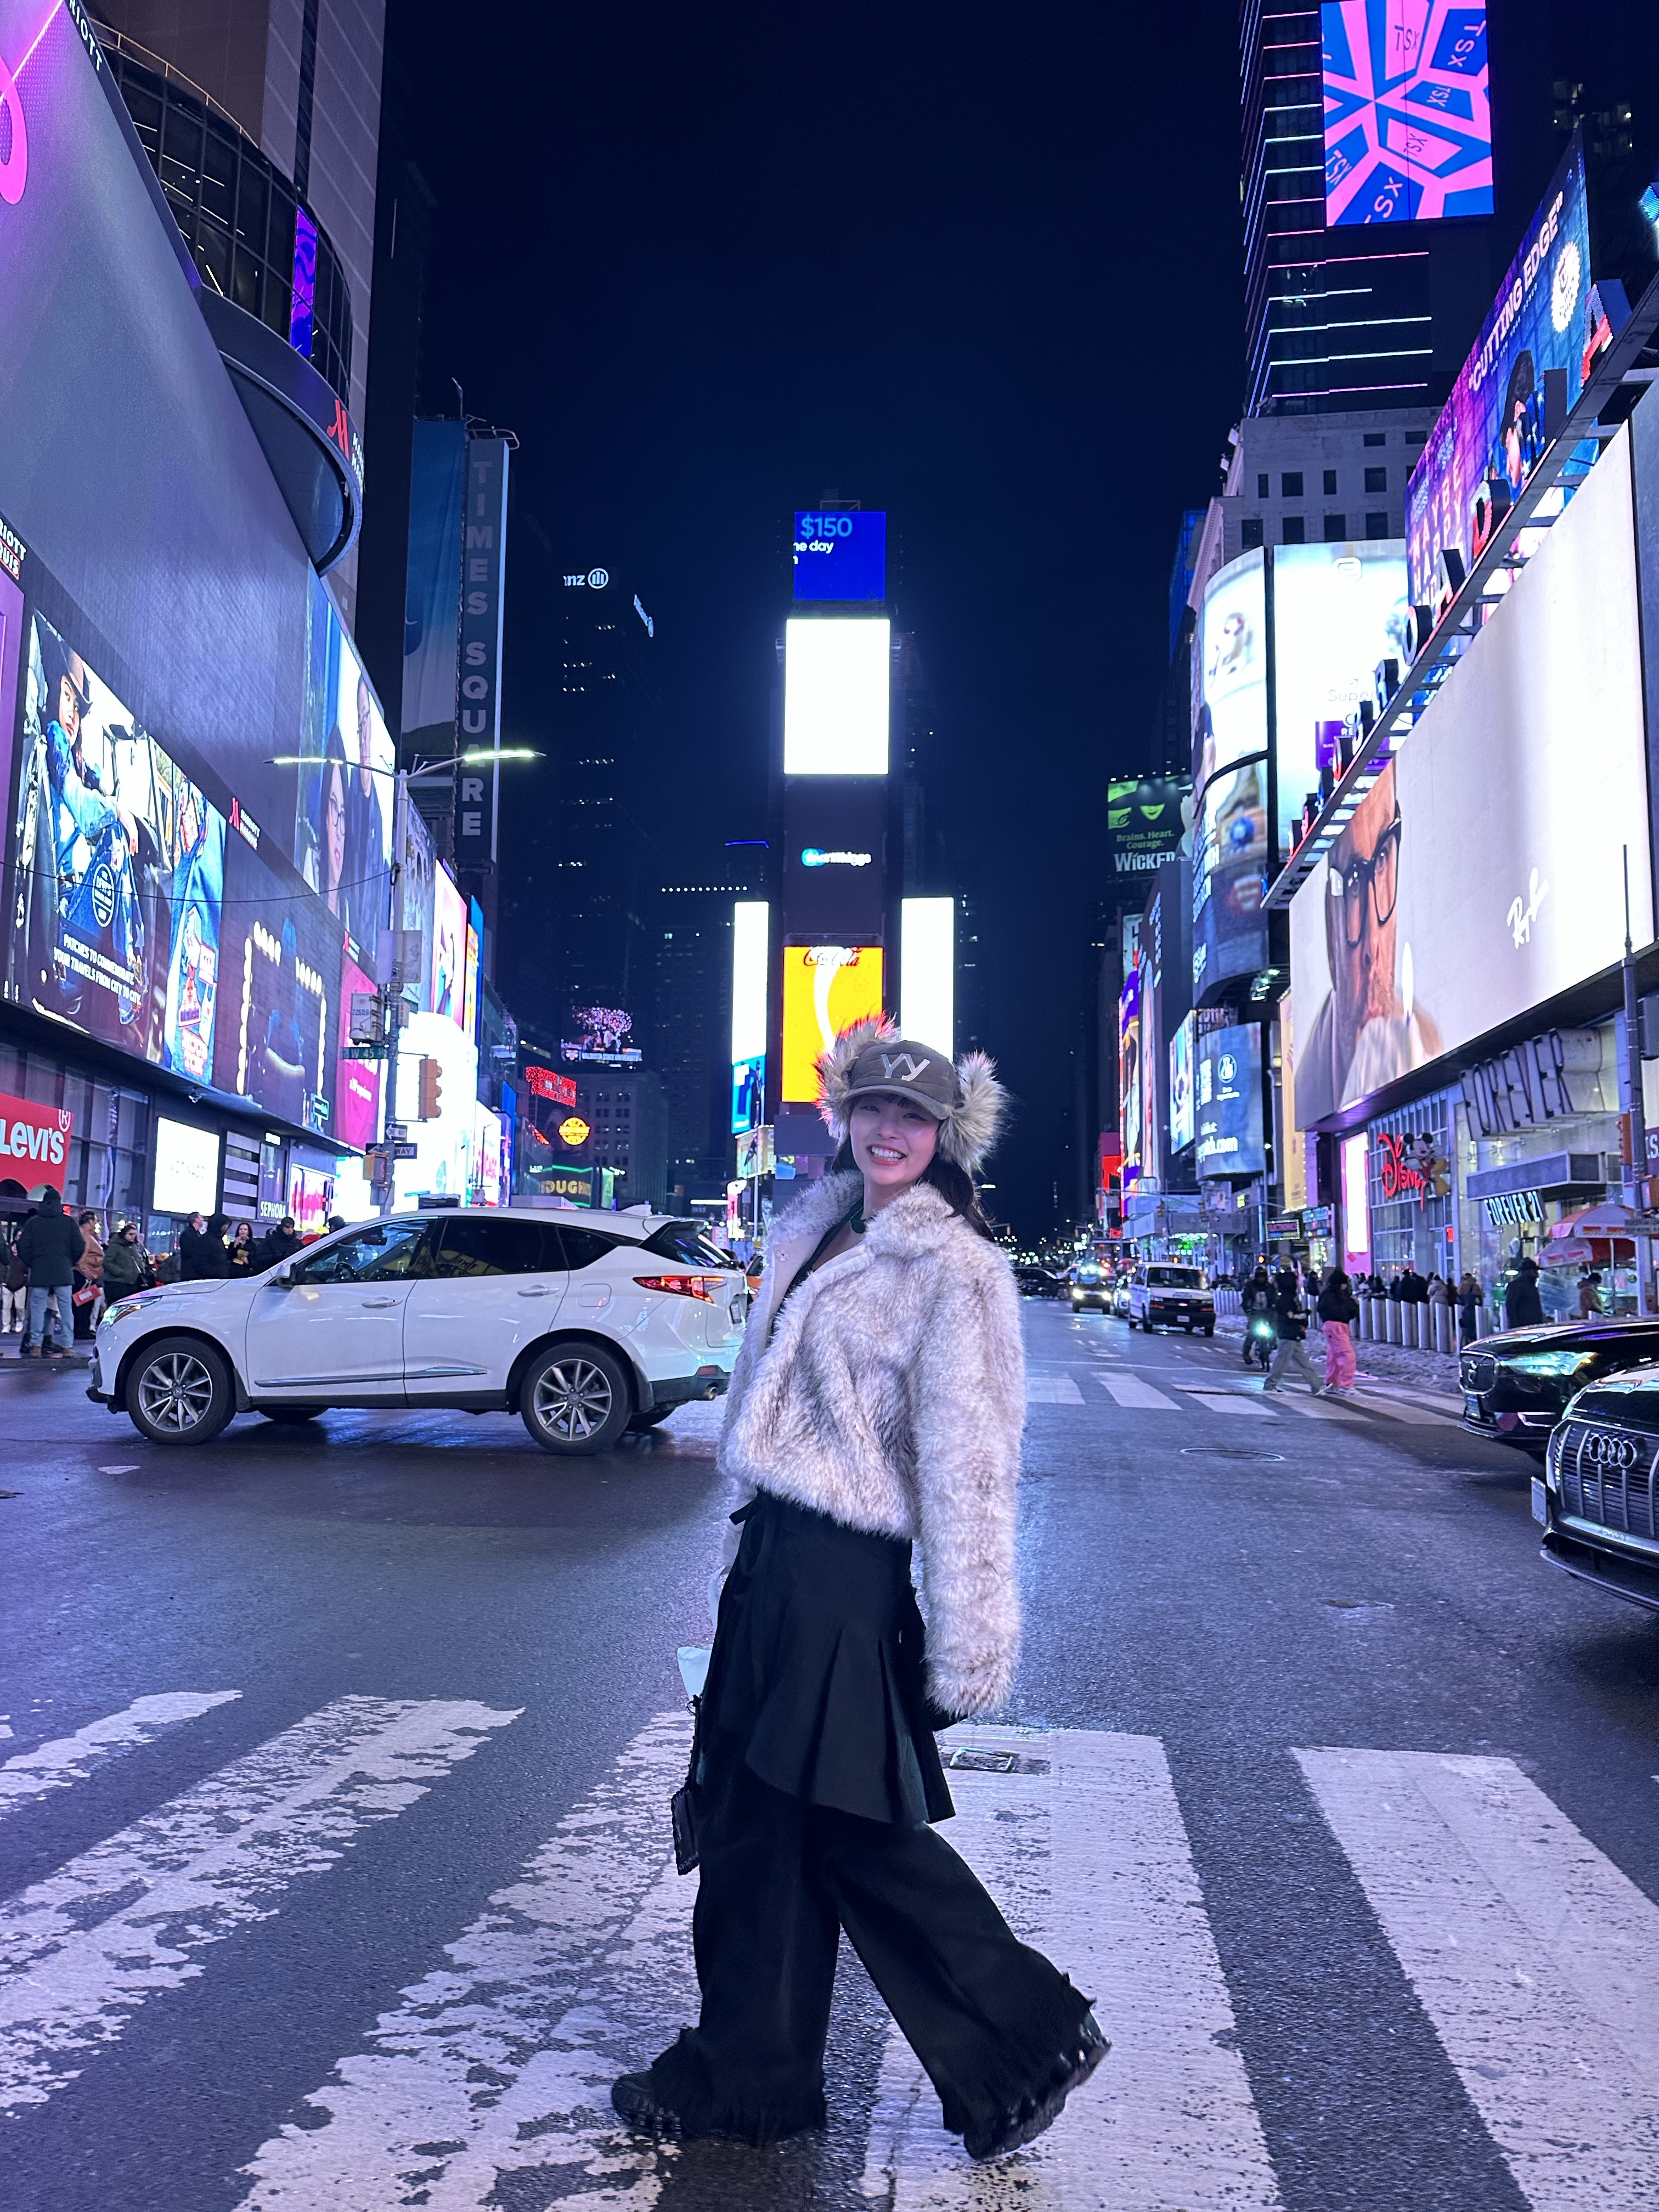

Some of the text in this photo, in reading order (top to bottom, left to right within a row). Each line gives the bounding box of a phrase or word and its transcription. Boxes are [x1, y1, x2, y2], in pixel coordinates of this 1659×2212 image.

[1394, 24, 1420, 51] TSX
[1427, 86, 1451, 108] TSX
[1403, 133, 1428, 156] TSX
[1364, 176, 1403, 224] SX
[466, 461, 493, 615] TIMES
[800, 513, 853, 539] $150
[809, 539, 834, 554] day
[64, 933, 89, 959] PATCHES
[89, 948, 97, 963] TO
[53, 946, 71, 968] YOUR
[71, 956, 96, 981] TRAVELS
[95, 970, 111, 989] FROM
[110, 979, 123, 995] CITY
[122, 985, 129, 1000] TO
[351, 1048, 359, 1059] W
[363, 1048, 374, 1059] 45
[260, 1200, 286, 1217] SEPHORA
[1483, 1190, 1543, 1226] FOREVER 21
